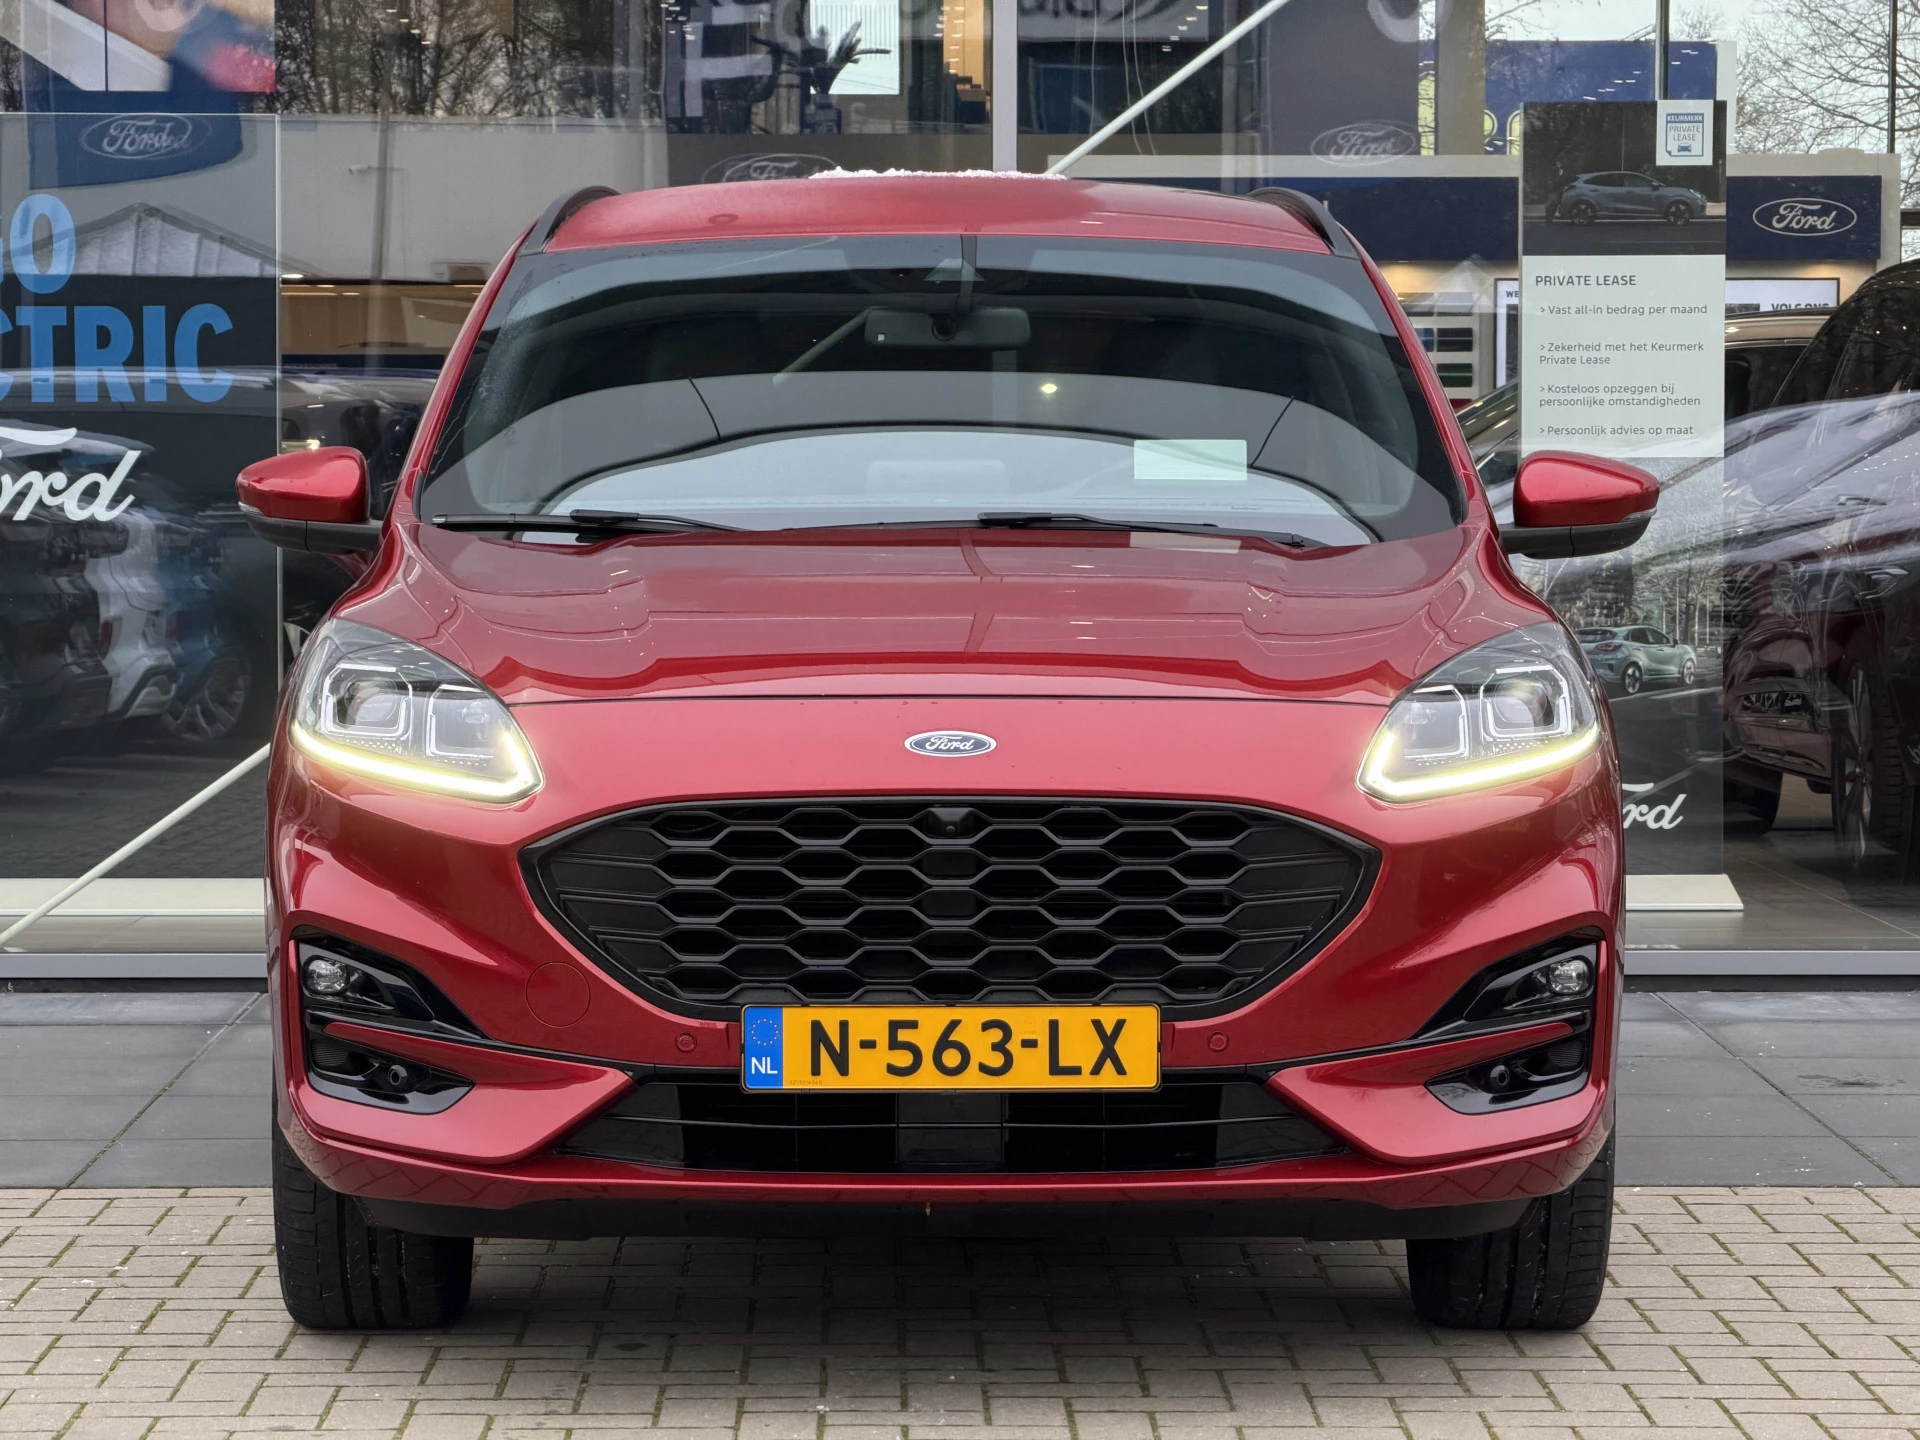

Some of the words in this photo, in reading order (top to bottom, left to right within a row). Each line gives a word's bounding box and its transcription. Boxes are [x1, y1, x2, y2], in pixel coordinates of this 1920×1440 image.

[1668, 125, 1701, 133] PRIVATE
[1772, 202, 1837, 230] Ford
[1535, 275, 1592, 287] PRIVATE
[1596, 275, 1637, 286] LEASE
[1548, 305, 1572, 315] Vast
[1574, 304, 1603, 315] all-in
[1606, 304, 1645, 316] bedrag
[1648, 306, 1668, 316] per
[1670, 304, 1708, 314] maand
[0, 303, 234, 402] TRIC
[1548, 342, 1601, 352] Zekerheid
[1604, 343, 1627, 352] met
[1629, 342, 1648, 351] het
[1651, 342, 1704, 351] Keurmerk
[1539, 355, 1577, 365] Private
[1580, 355, 1611, 365] Lease
[1547, 384, 1600, 394] Kosteloos
[1603, 386, 1658, 395] opzeggen
[1661, 383, 1675, 395] bij
[1539, 396, 1605, 408] persoonlijke
[1608, 396, 1701, 408] omstandigheden
[1547, 425, 1607, 437] Persoonlijk
[1610, 425, 1645, 435] advies
[1648, 427, 1663, 437] op
[1665, 426, 1694, 435] maat
[925, 735, 976, 750] Ford
[810, 1019, 1127, 1077] N-563-LX
[751, 1056, 779, 1075] NL
